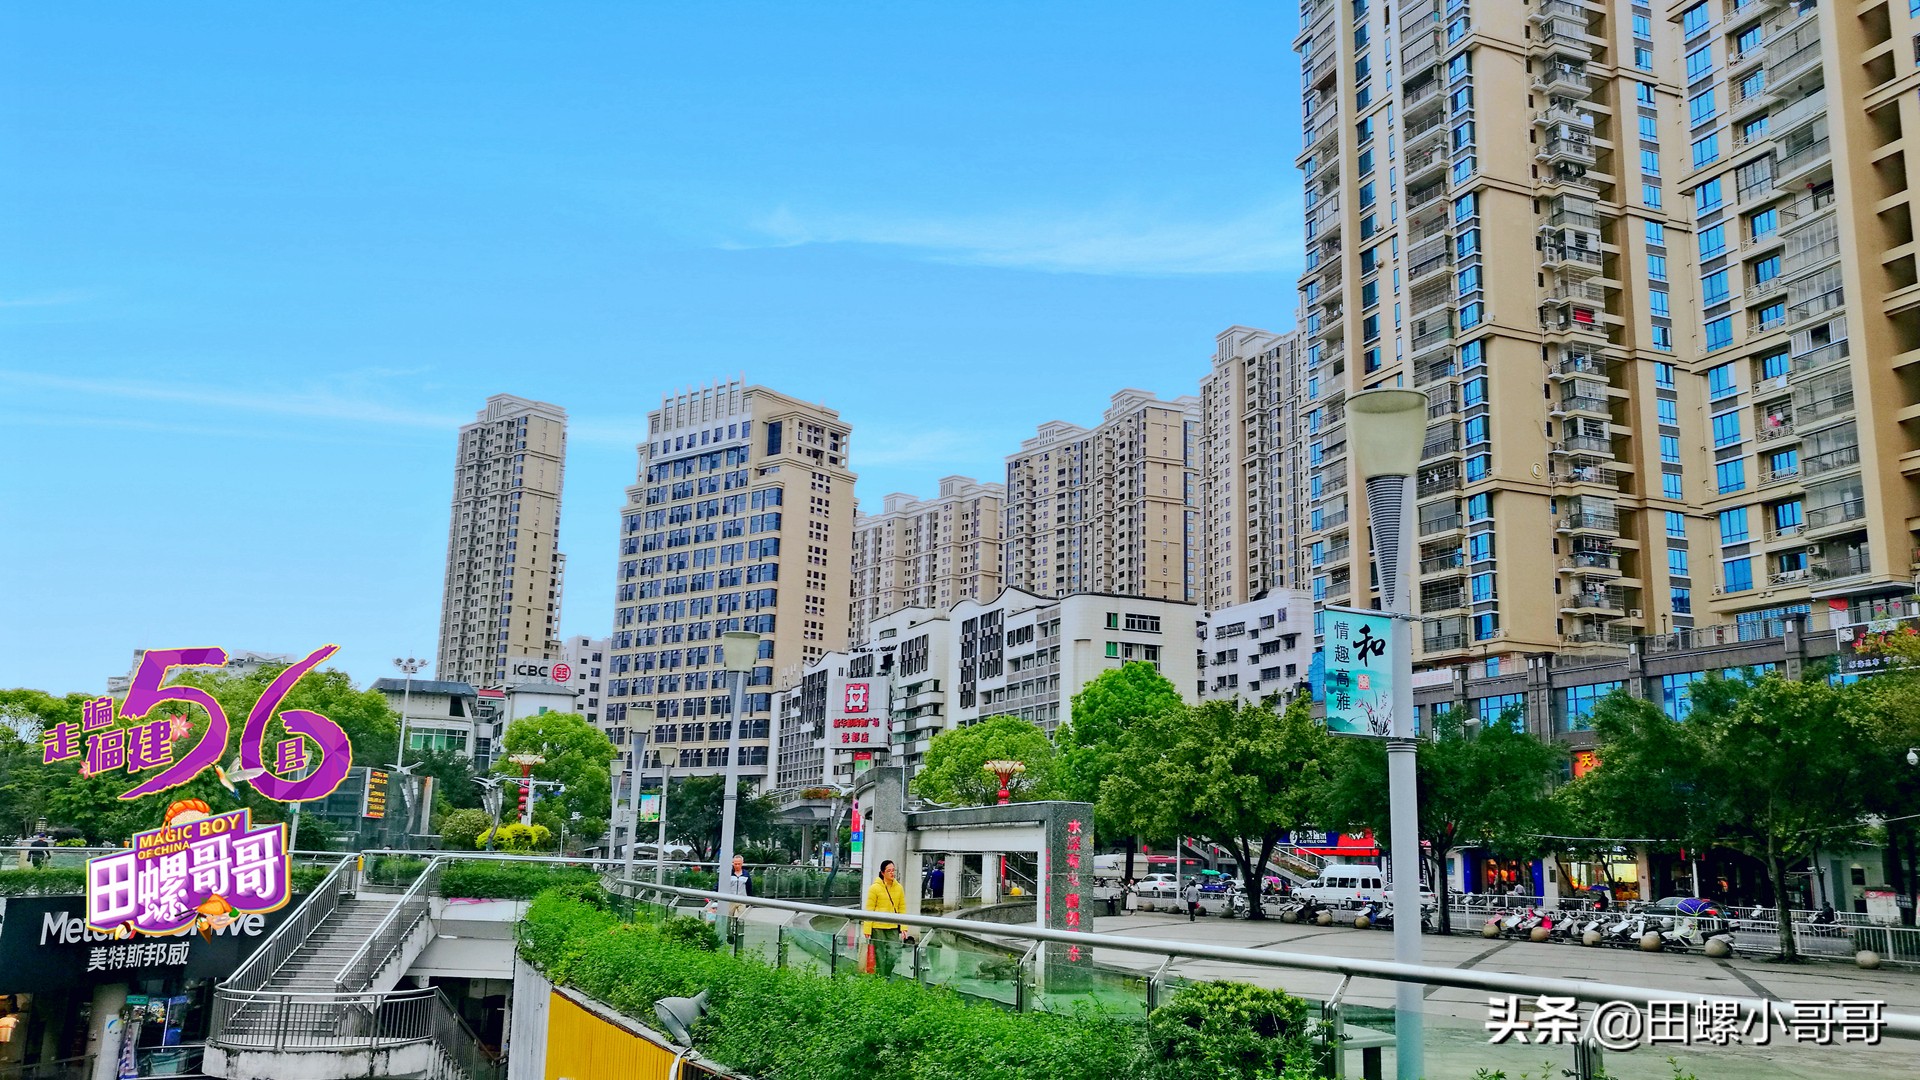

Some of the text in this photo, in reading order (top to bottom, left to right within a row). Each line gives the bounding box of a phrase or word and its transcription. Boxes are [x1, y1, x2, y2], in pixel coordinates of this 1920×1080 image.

[1353, 624, 1386, 667] 和
[513, 664, 549, 677] ICBC
[1334, 621, 1351, 711] 情趣高雅
[87, 941, 190, 971] 美特斯邦威
